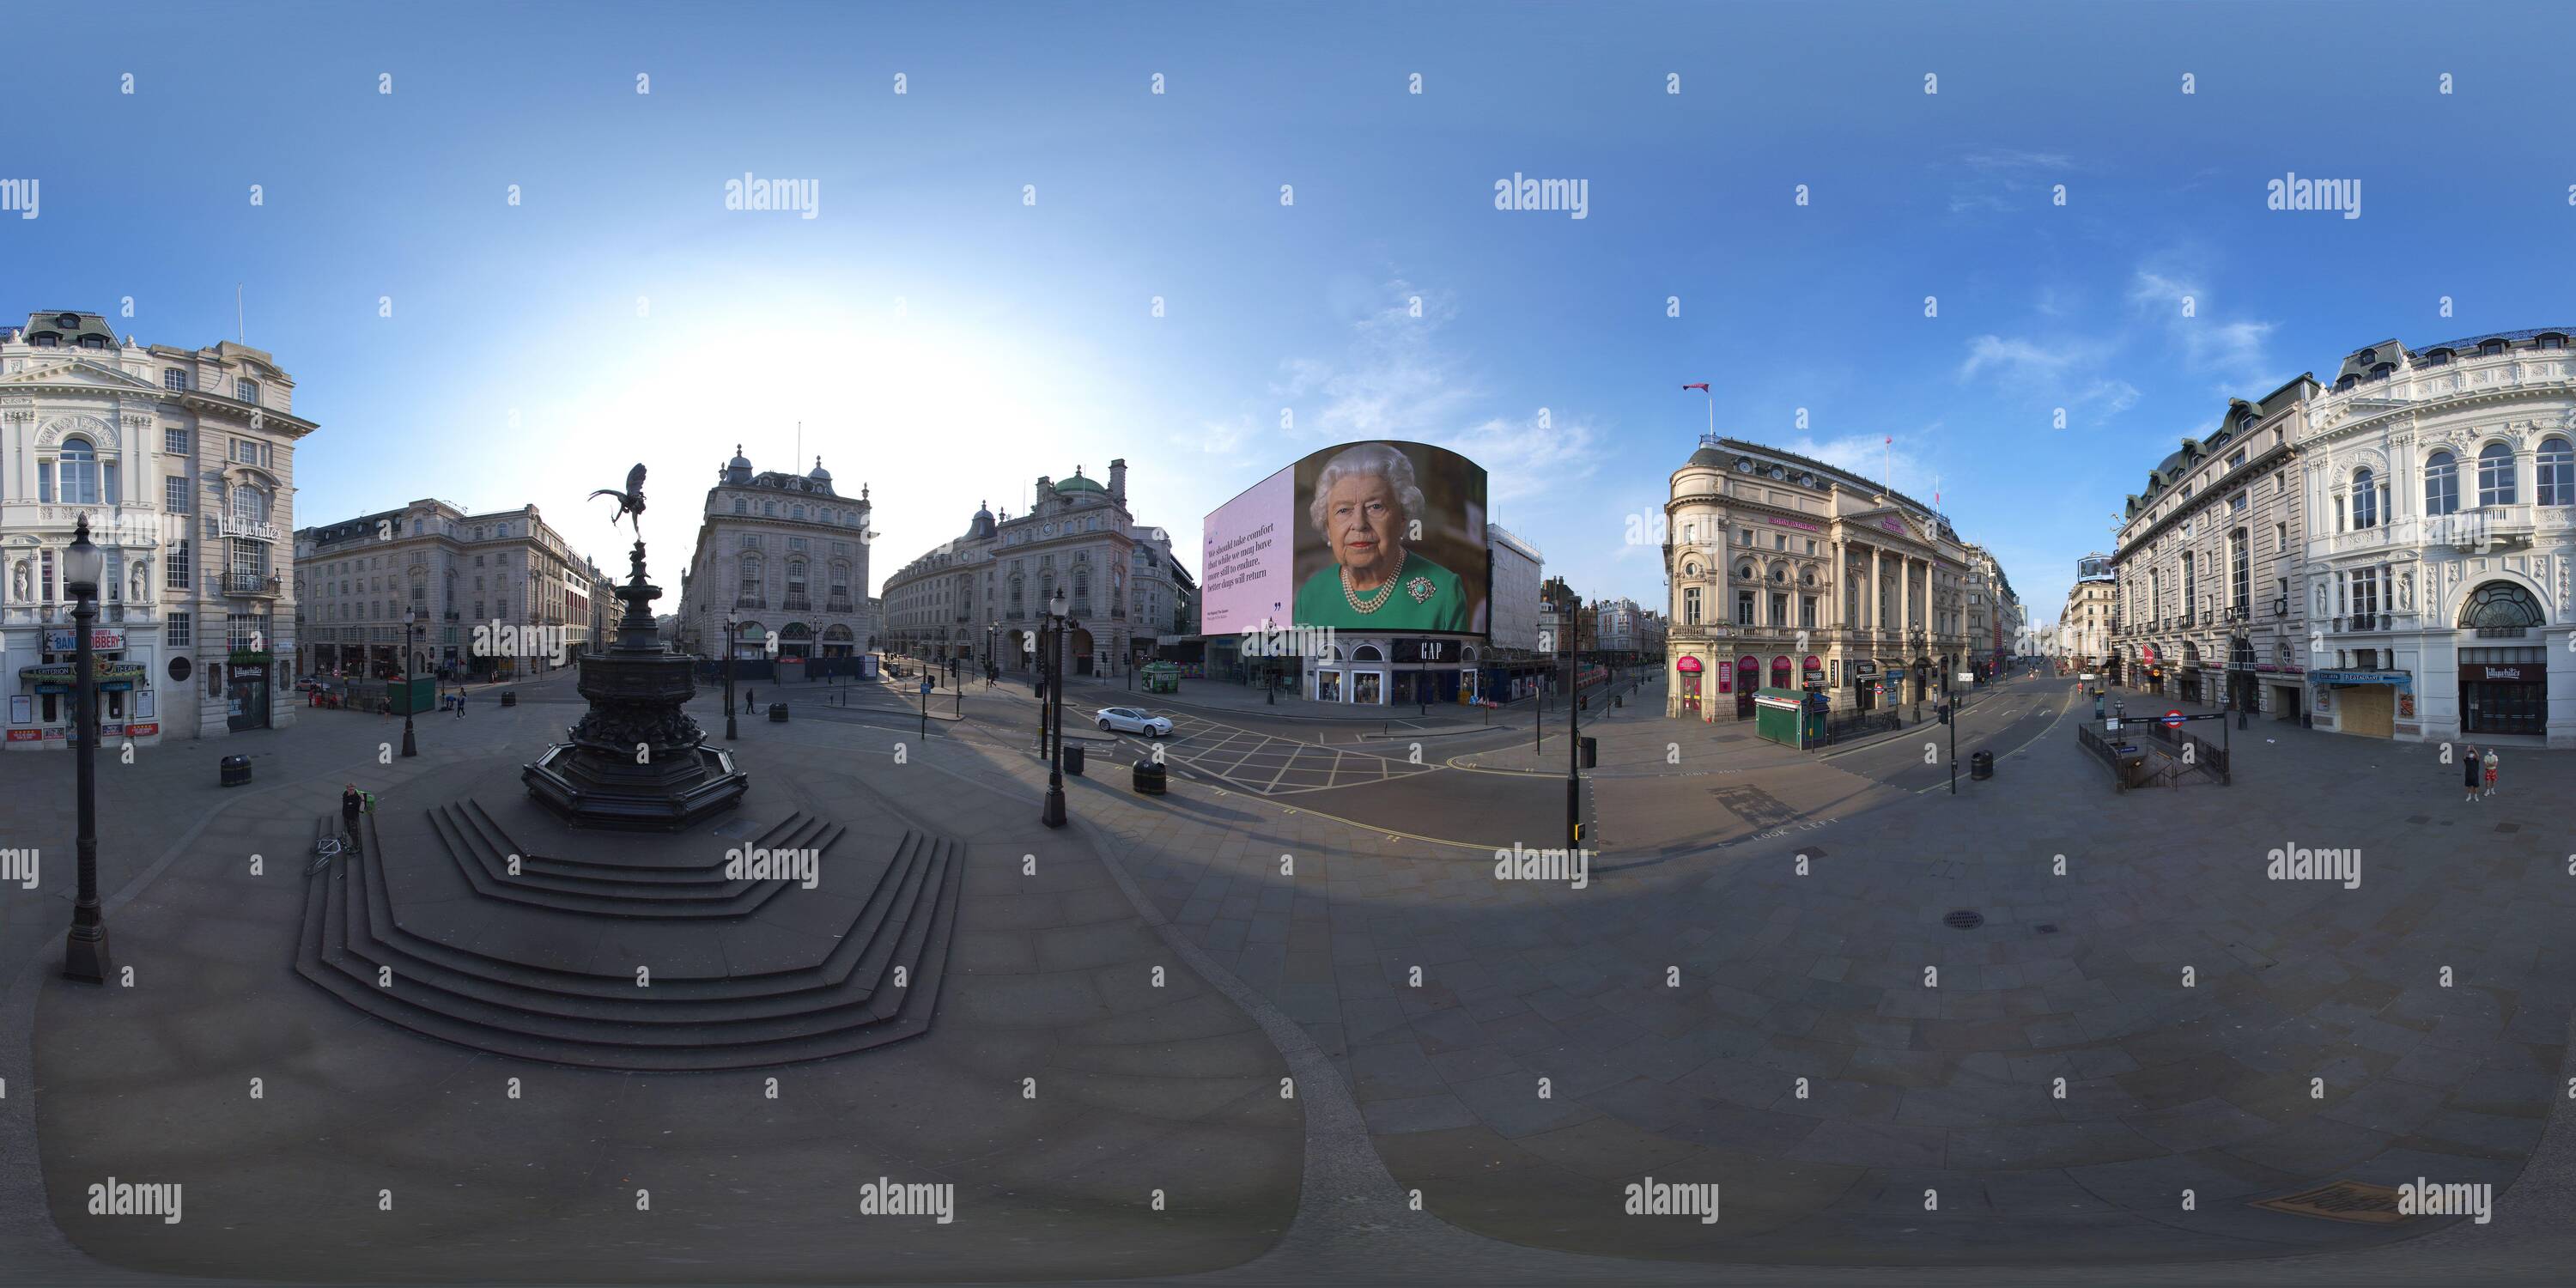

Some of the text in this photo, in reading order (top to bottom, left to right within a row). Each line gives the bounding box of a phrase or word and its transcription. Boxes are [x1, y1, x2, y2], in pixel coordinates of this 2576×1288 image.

[217, 512, 282, 544] Lillywhites
[1216, 539, 1233, 556] should
[1234, 536, 1246, 547] take
[1247, 523, 1273, 542] comfort
[1208, 539, 1272, 570] that while we may have
[1207, 572, 1220, 581] more
[1221, 566, 1230, 577] still
[1230, 565, 1236, 574] to
[1207, 569, 1267, 592] better days will return
[56, 635, 119, 649] BAN OBBERY
[1422, 642, 1442, 659] GAP
[38, 666, 69, 675] CRITERION
[2486, 666, 2520, 679] Lillywhites
